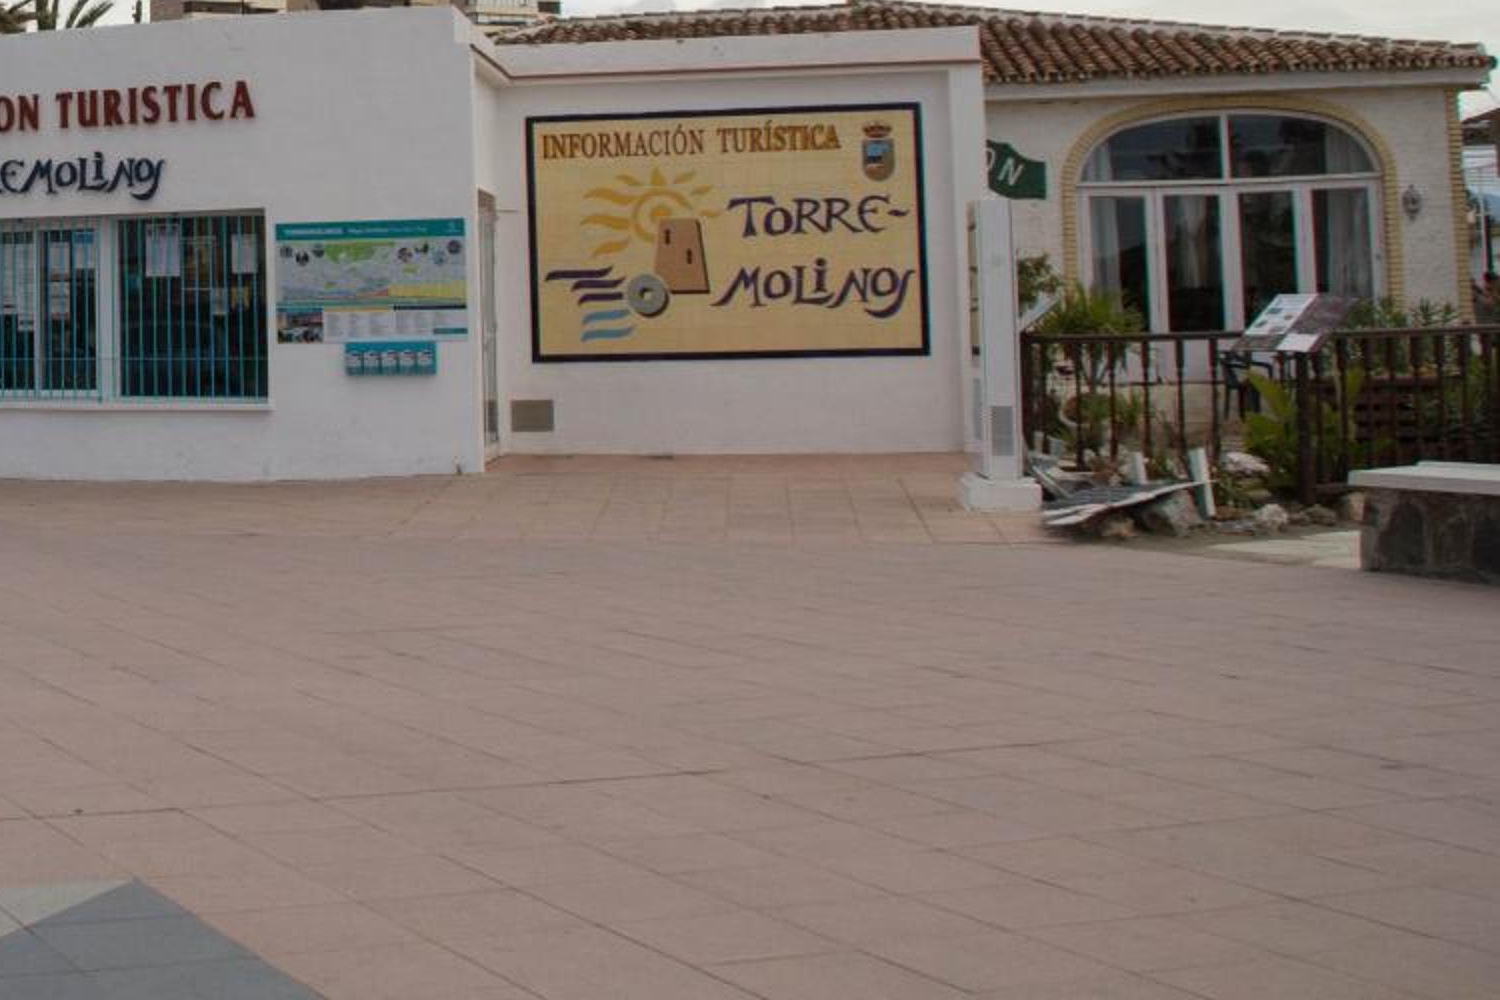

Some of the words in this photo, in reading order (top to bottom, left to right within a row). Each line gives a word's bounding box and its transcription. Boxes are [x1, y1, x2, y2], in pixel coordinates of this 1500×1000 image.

[55, 80, 256, 130] TURISTICA
[542, 123, 705, 160] INFORMACIÓN
[717, 118, 842, 154] TURÍSTICA
[726, 193, 910, 239] TORRE-
[709, 256, 916, 320] MOLINOS
